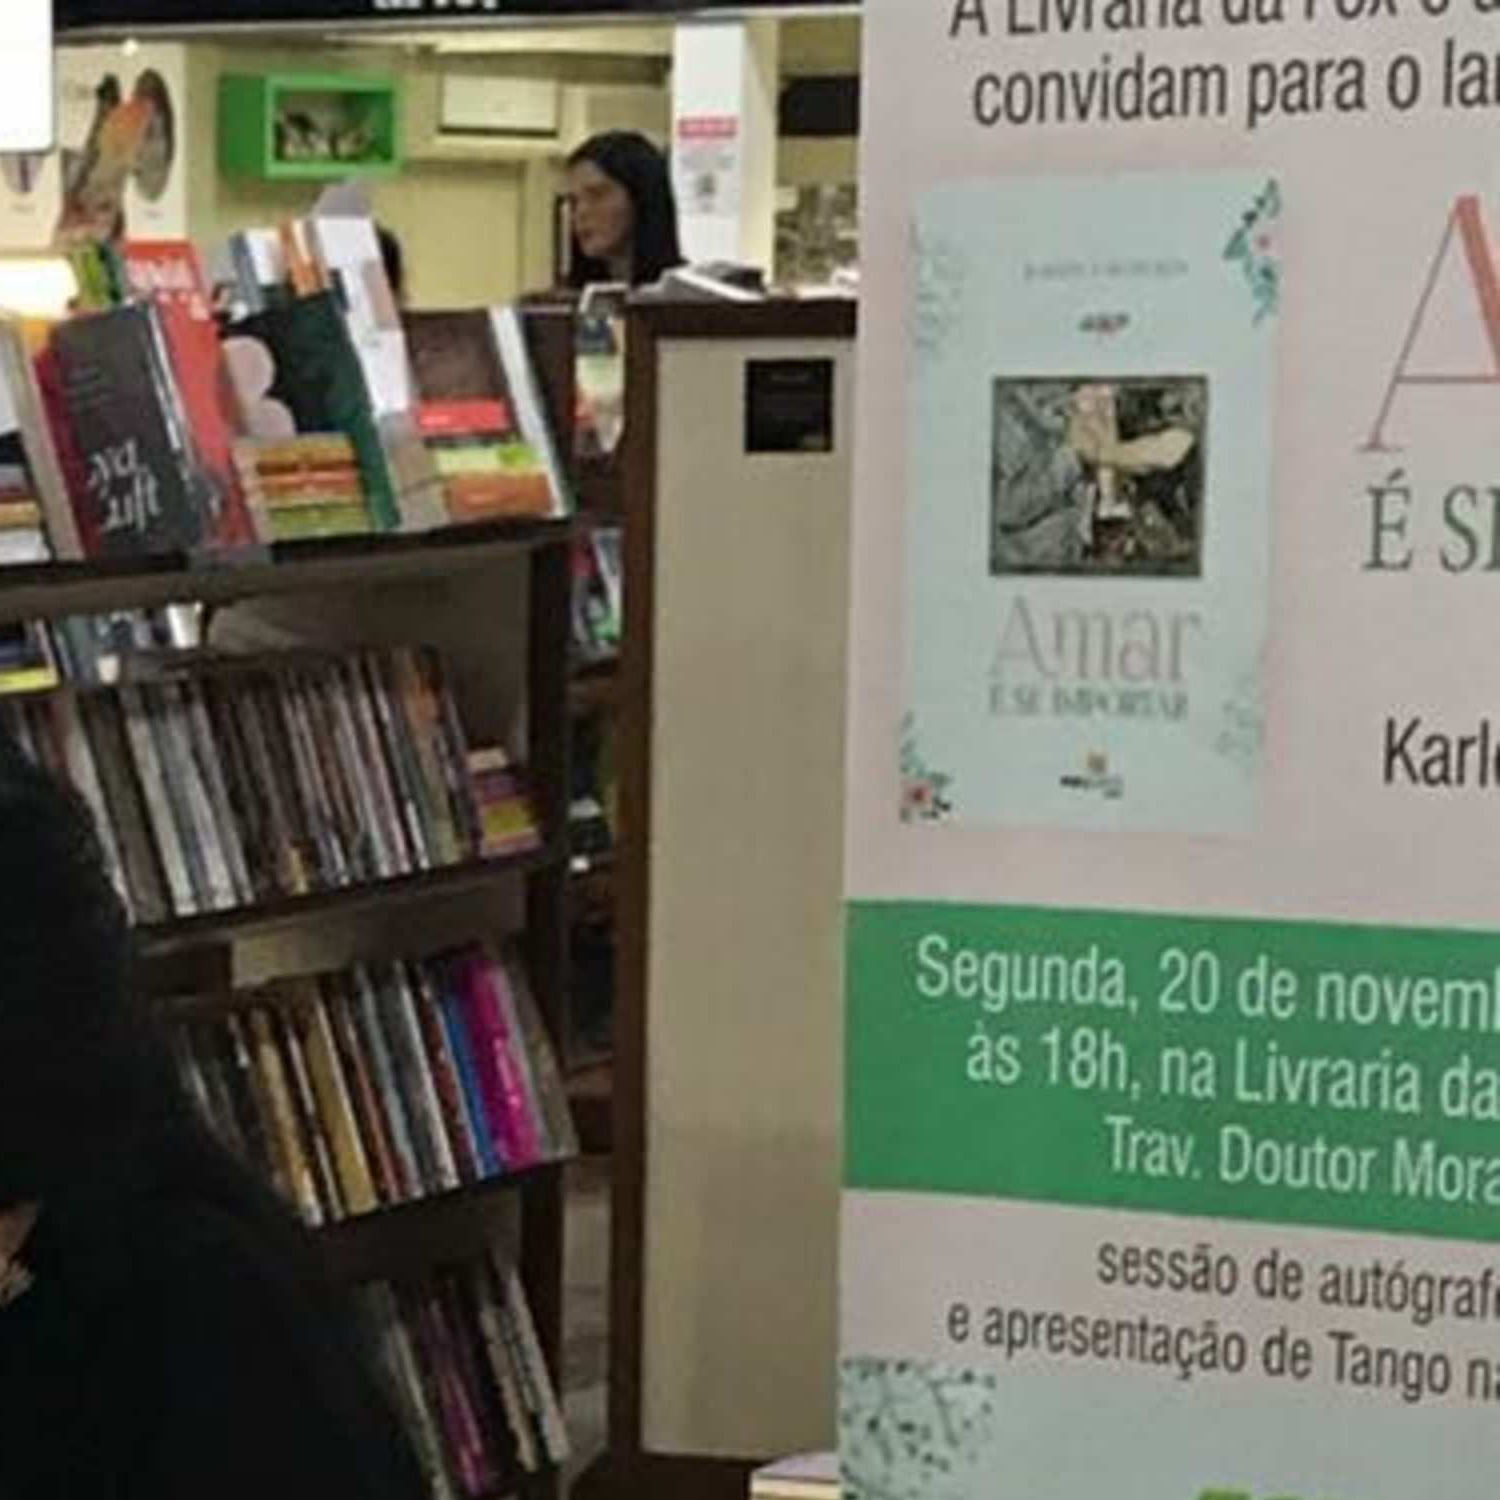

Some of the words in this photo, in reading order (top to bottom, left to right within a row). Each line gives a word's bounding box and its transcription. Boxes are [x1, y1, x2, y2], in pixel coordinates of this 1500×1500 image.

[972, 52, 1227, 126] convidam
[1248, 57, 1366, 128] para
[1387, 50, 1422, 110] o
[1443, 37, 1500, 109] la
[1361, 468, 1412, 572] É
[1384, 716, 1500, 788] Karl
[915, 933, 1139, 1014] Segunda,
[1158, 947, 1220, 1014] 20
[1237, 953, 1298, 1019] de
[1316, 965, 1500, 1032] novem
[966, 1019, 1022, 1085] às
[1040, 1025, 1142, 1102] 18h,
[1160, 1046, 1217, 1100] na
[1234, 1038, 1421, 1114] Livraria
[1440, 1053, 1500, 1120] da
[1104, 1114, 1203, 1180] Trav.
[1218, 1123, 1378, 1192] Doutor
[1098, 1242, 1238, 1297] sessão
[1253, 1248, 1304, 1301] de
[1319, 1260, 1500, 1326] autógraf
[947, 1302, 970, 1343] e
[983, 1305, 1247, 1381] apresentação
[1262, 1328, 1313, 1380] de
[1327, 1331, 1451, 1402] Tango
[1467, 1357, 1500, 1401] n
